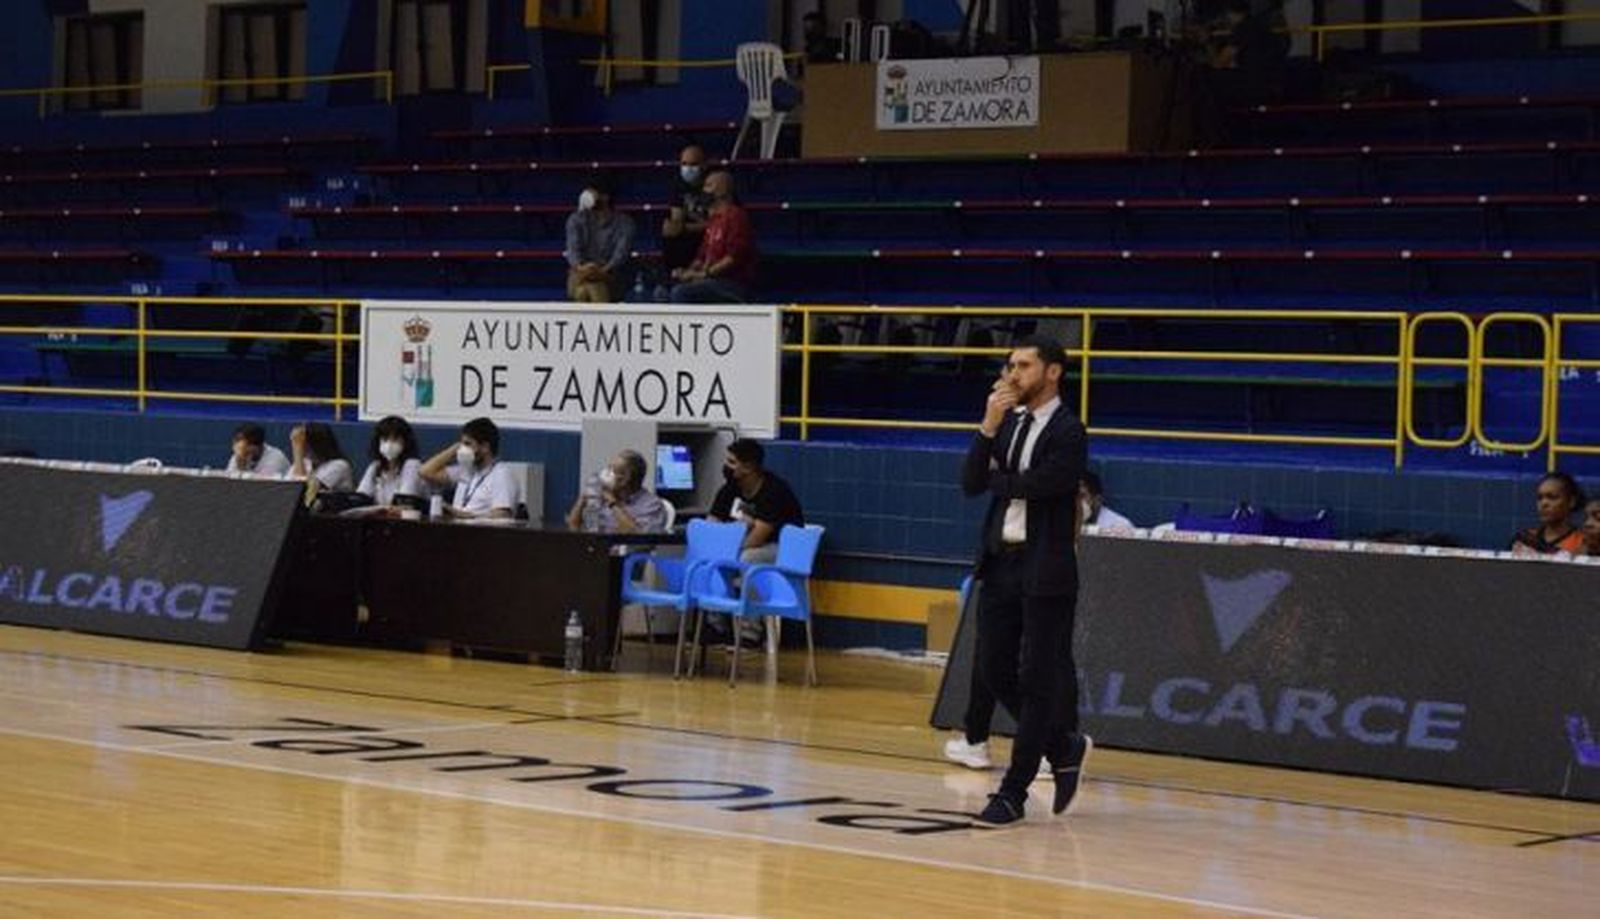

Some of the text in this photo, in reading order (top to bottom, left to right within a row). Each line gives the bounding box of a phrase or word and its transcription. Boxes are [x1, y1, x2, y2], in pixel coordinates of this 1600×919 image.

[914, 75, 1032, 96] AYUNTAMIENTO
[912, 98, 1030, 123] DE ZAMORA
[461, 319, 735, 357] AYUNTAMIENTO
[460, 364, 732, 419] DE ZAMORA
[120, 716, 1000, 836] Zamora
